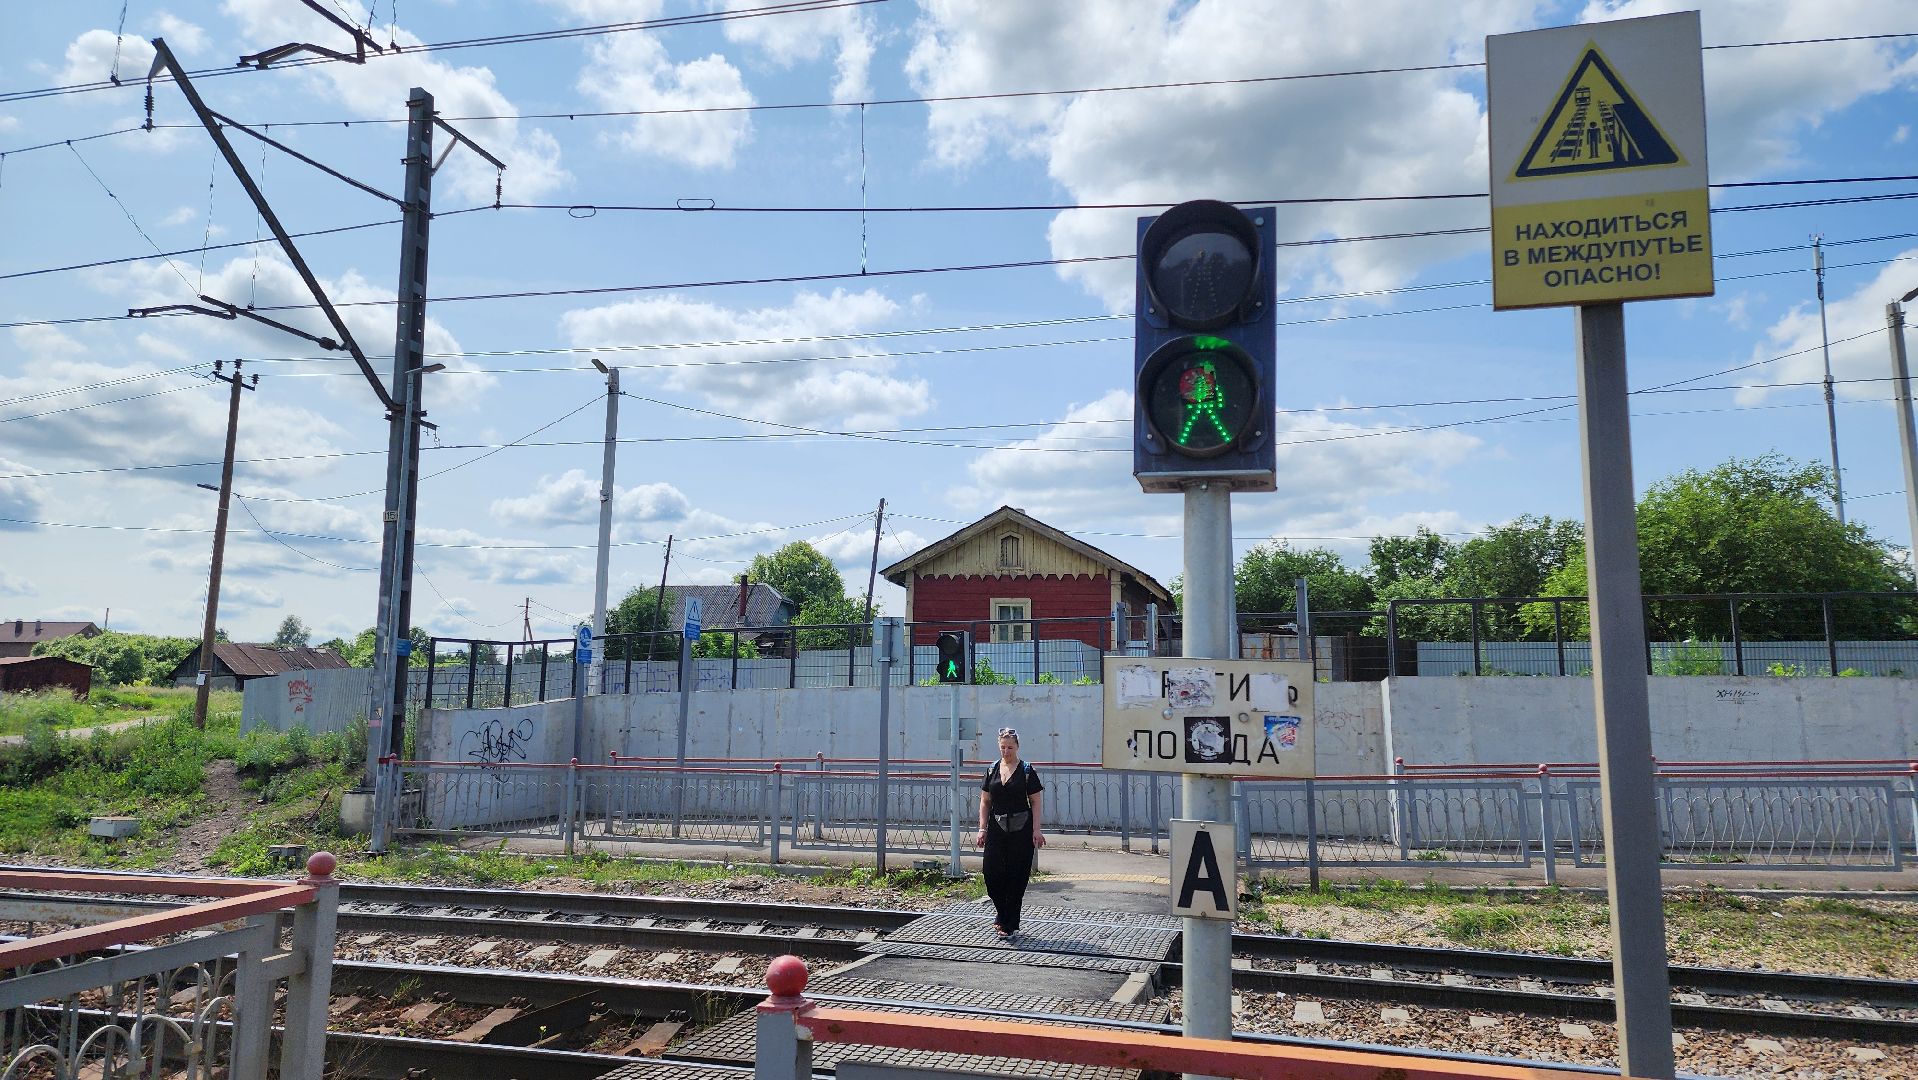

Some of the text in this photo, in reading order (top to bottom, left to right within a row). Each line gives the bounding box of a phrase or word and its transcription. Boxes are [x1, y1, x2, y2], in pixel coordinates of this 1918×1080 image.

[1516, 210, 1688, 241] НАХОДИТЬСЯ
[1504, 234, 1704, 266] В МЕЖДУПУТЬЕ
[1544, 263, 1662, 287] ОПАСНО!
[1134, 729, 1280, 765] ПОДА
[1177, 830, 1230, 912] А
